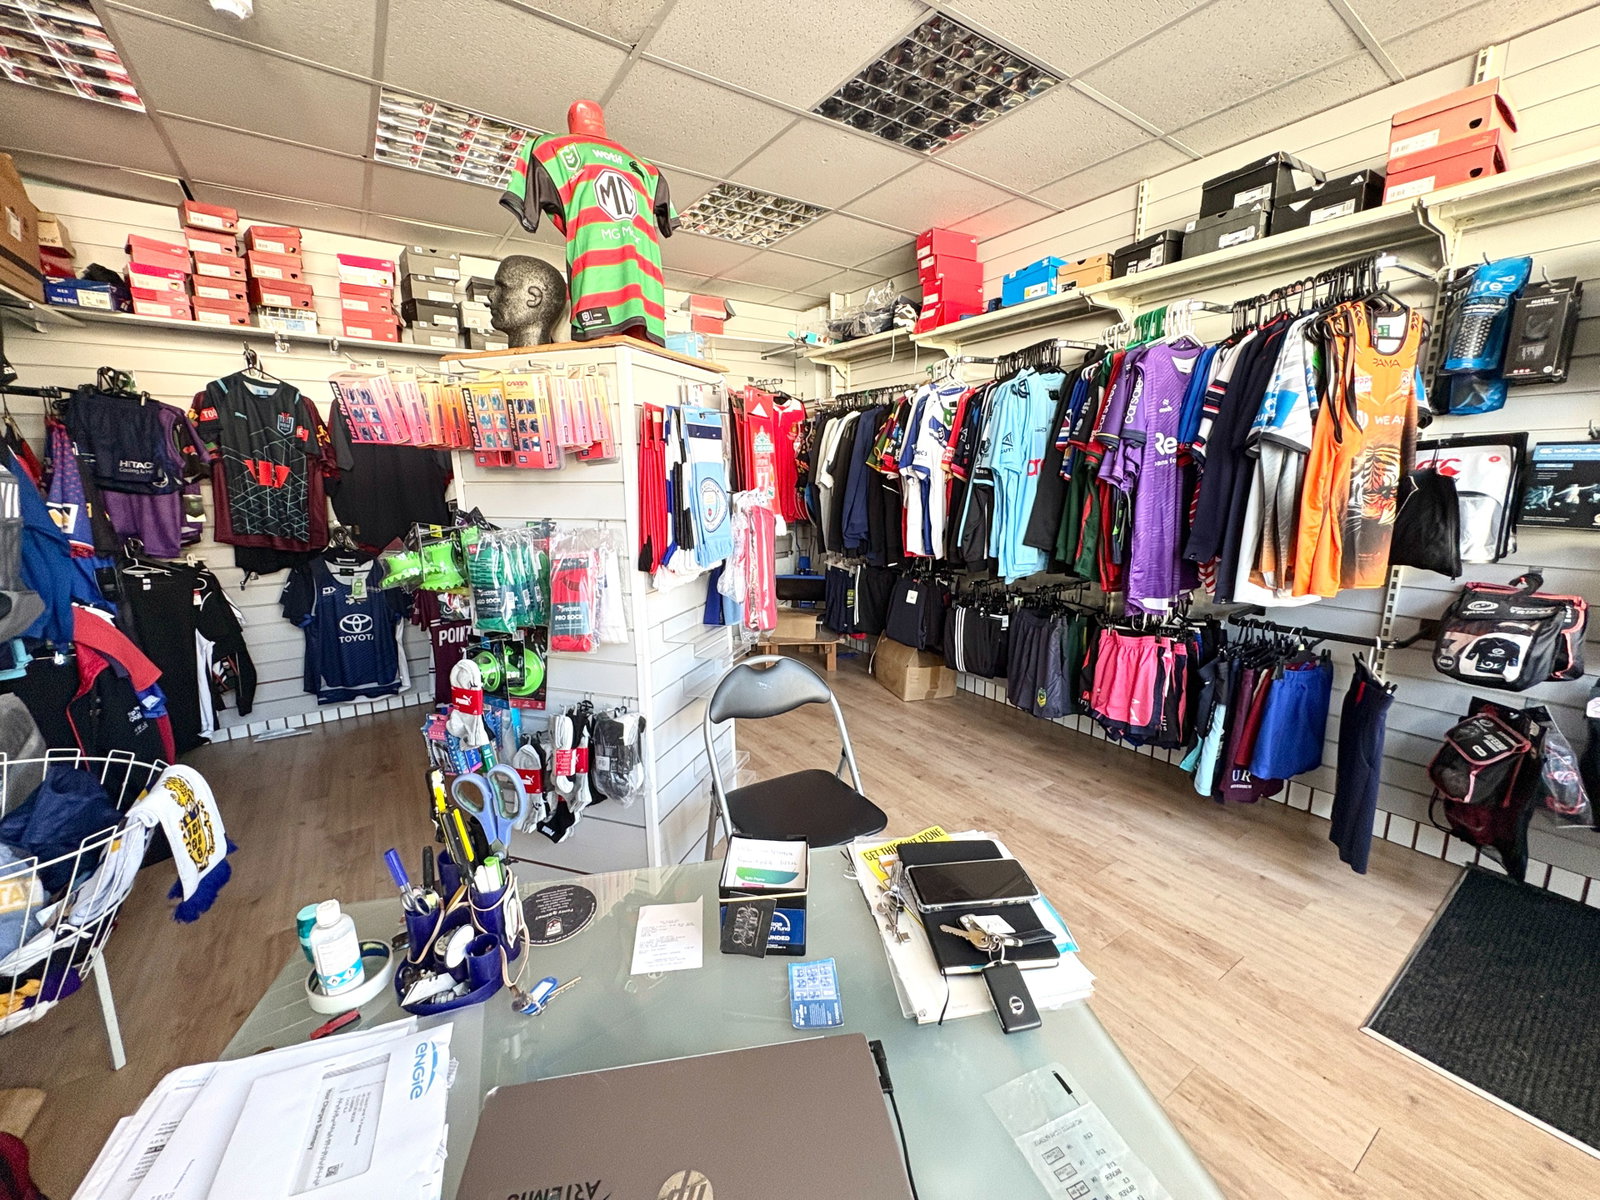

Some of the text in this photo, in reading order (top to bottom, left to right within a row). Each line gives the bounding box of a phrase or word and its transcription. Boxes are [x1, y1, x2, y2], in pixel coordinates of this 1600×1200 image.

[592, 149, 623, 165] wotif
[600, 176, 634, 215] MG
[600, 228, 621, 240] MG
[331, 383, 359, 440] neo therm
[463, 389, 482, 447] neo therm
[1374, 415, 1390, 425] WE
[863, 850, 880, 861] GET
[879, 843, 898, 857] THIS
[921, 827, 945, 843] DONE
